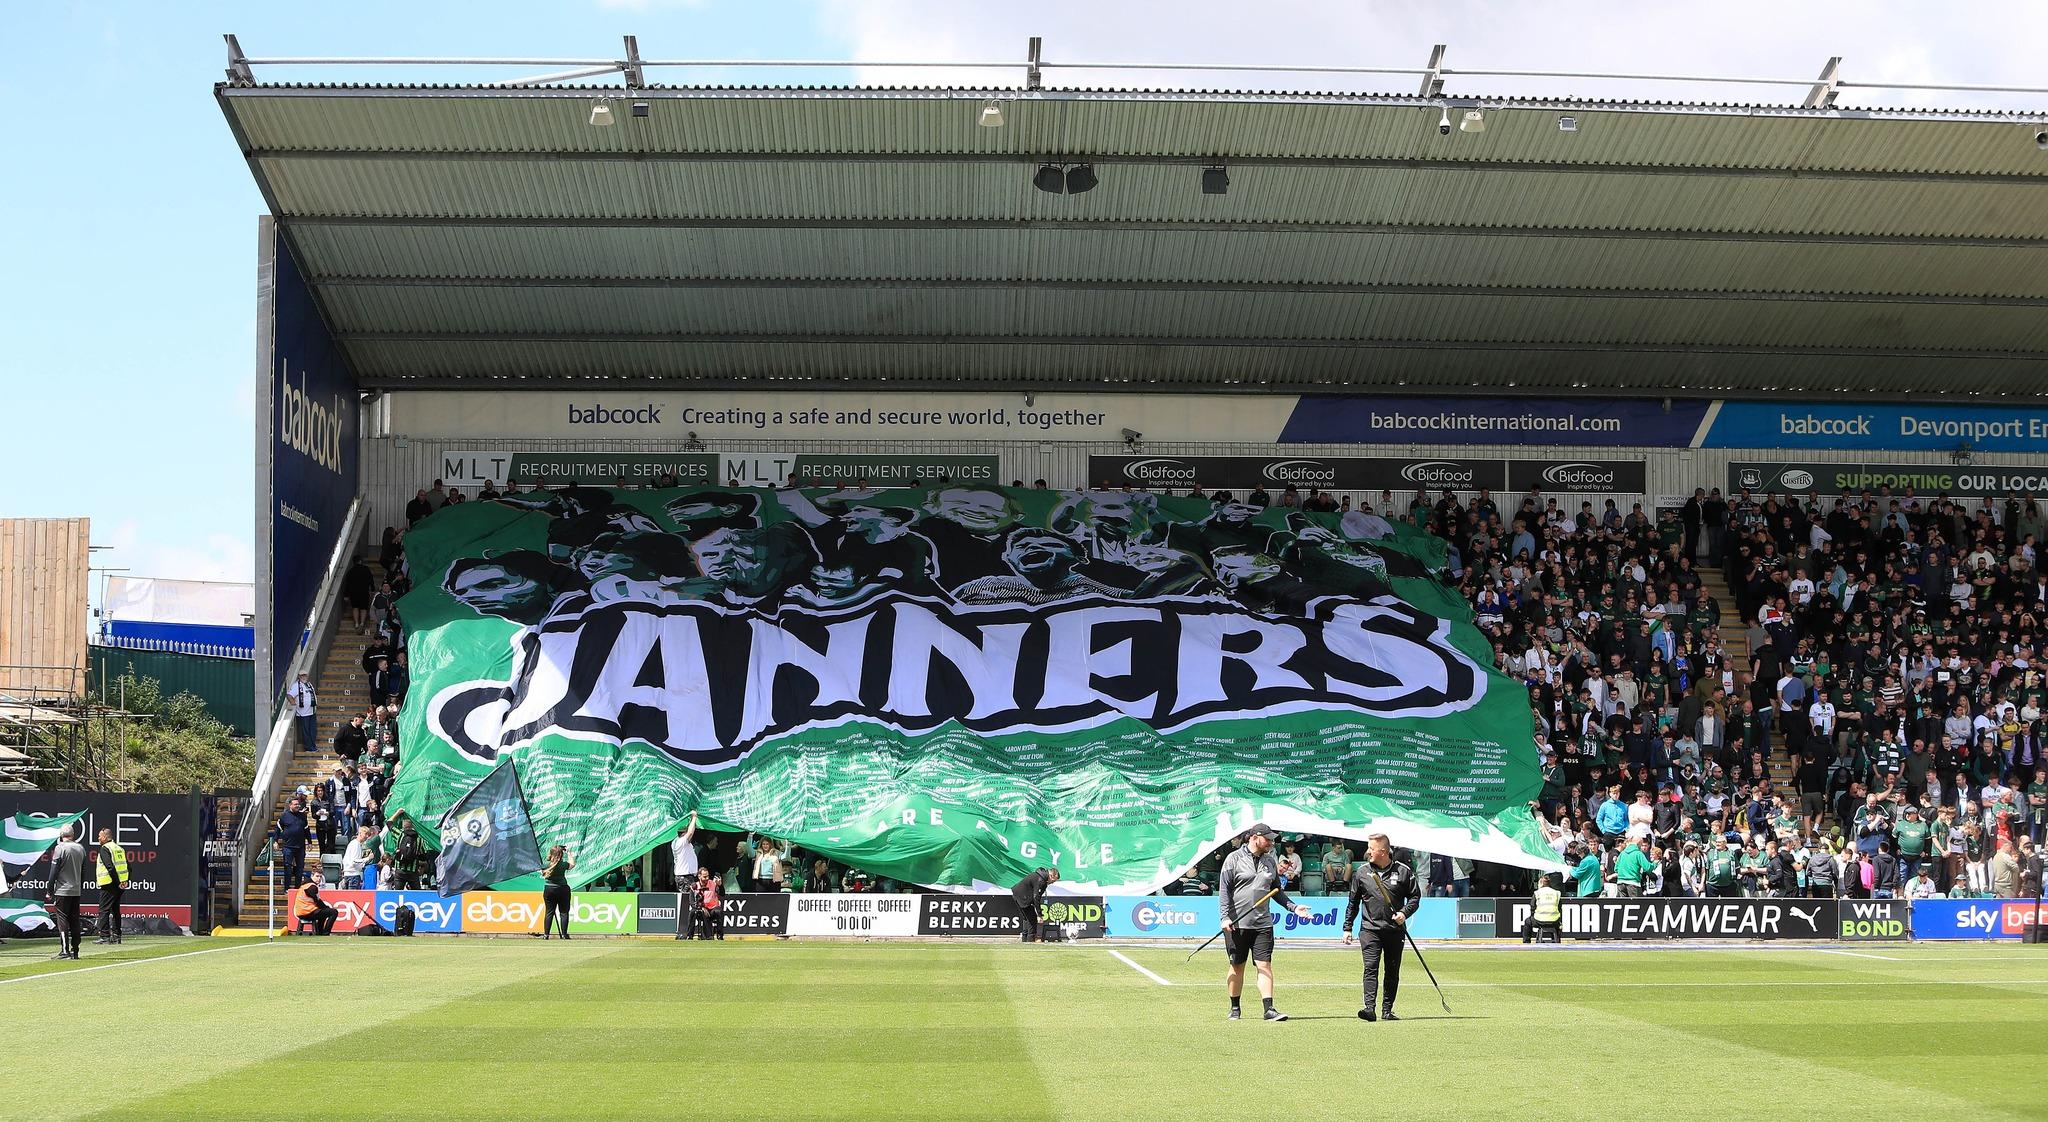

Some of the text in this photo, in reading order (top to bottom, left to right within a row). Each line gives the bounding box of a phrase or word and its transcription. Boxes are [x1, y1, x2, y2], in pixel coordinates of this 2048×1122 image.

[281, 357, 342, 475] babcock
[568, 404, 661, 424] babcock
[682, 408, 1105, 430] Creating a safe and secure world, together
[1371, 412, 1621, 431] babcockinternational.com
[1780, 414, 1870, 435] babcock
[1900, 416, 2023, 442] Devonport
[445, 459, 708, 479] MLT RECRUITMENT SERVICES
[727, 460, 991, 482] MLT RECRUITMENT SERVICES
[1140, 465, 1195, 479] Bidfood
[1279, 466, 1335, 480] Bidfood
[1418, 467, 1473, 482] Bidfood
[1148, 479, 1172, 487] Inspired
[1174, 479, 1182, 487] by
[1287, 480, 1311, 488] Inspired
[1313, 480, 1320, 488] by
[1559, 470, 1614, 484] Bidfood
[1836, 473, 1952, 490] SUPPORTING
[1958, 475, 1997, 491] OUR
[1426, 481, 1450, 489] Inspired
[1451, 481, 1459, 489] by
[1567, 483, 1591, 491] Inspired
[1592, 483, 1600, 491] by
[463, 602, 1448, 750] JANNERS
[1264, 732, 1277, 740] STEVE
[1260, 742, 1280, 751] NATALIE
[1426, 748, 1444, 757] WALKER
[1376, 768, 1385, 776] THE
[1470, 768, 1484, 776] JOHN
[976, 818, 1114, 869] AGYLE
[89, 850, 157, 863] GOUP
[467, 895, 545, 930] ebay
[798, 899, 912, 912] COFFEE! COFFEE! COFFEE!
[928, 901, 987, 913] PERKY
[1852, 903, 1891, 919] WH
[723, 915, 780, 928] NDERS
[928, 916, 1020, 929] BLENDERS
[1139, 905, 1196, 925] extra
[1285, 908, 1338, 930] good
[1512, 904, 1781, 933] PMA TEAMWEAR
[1956, 905, 1999, 933] sky
[1842, 920, 1903, 936] BOND
